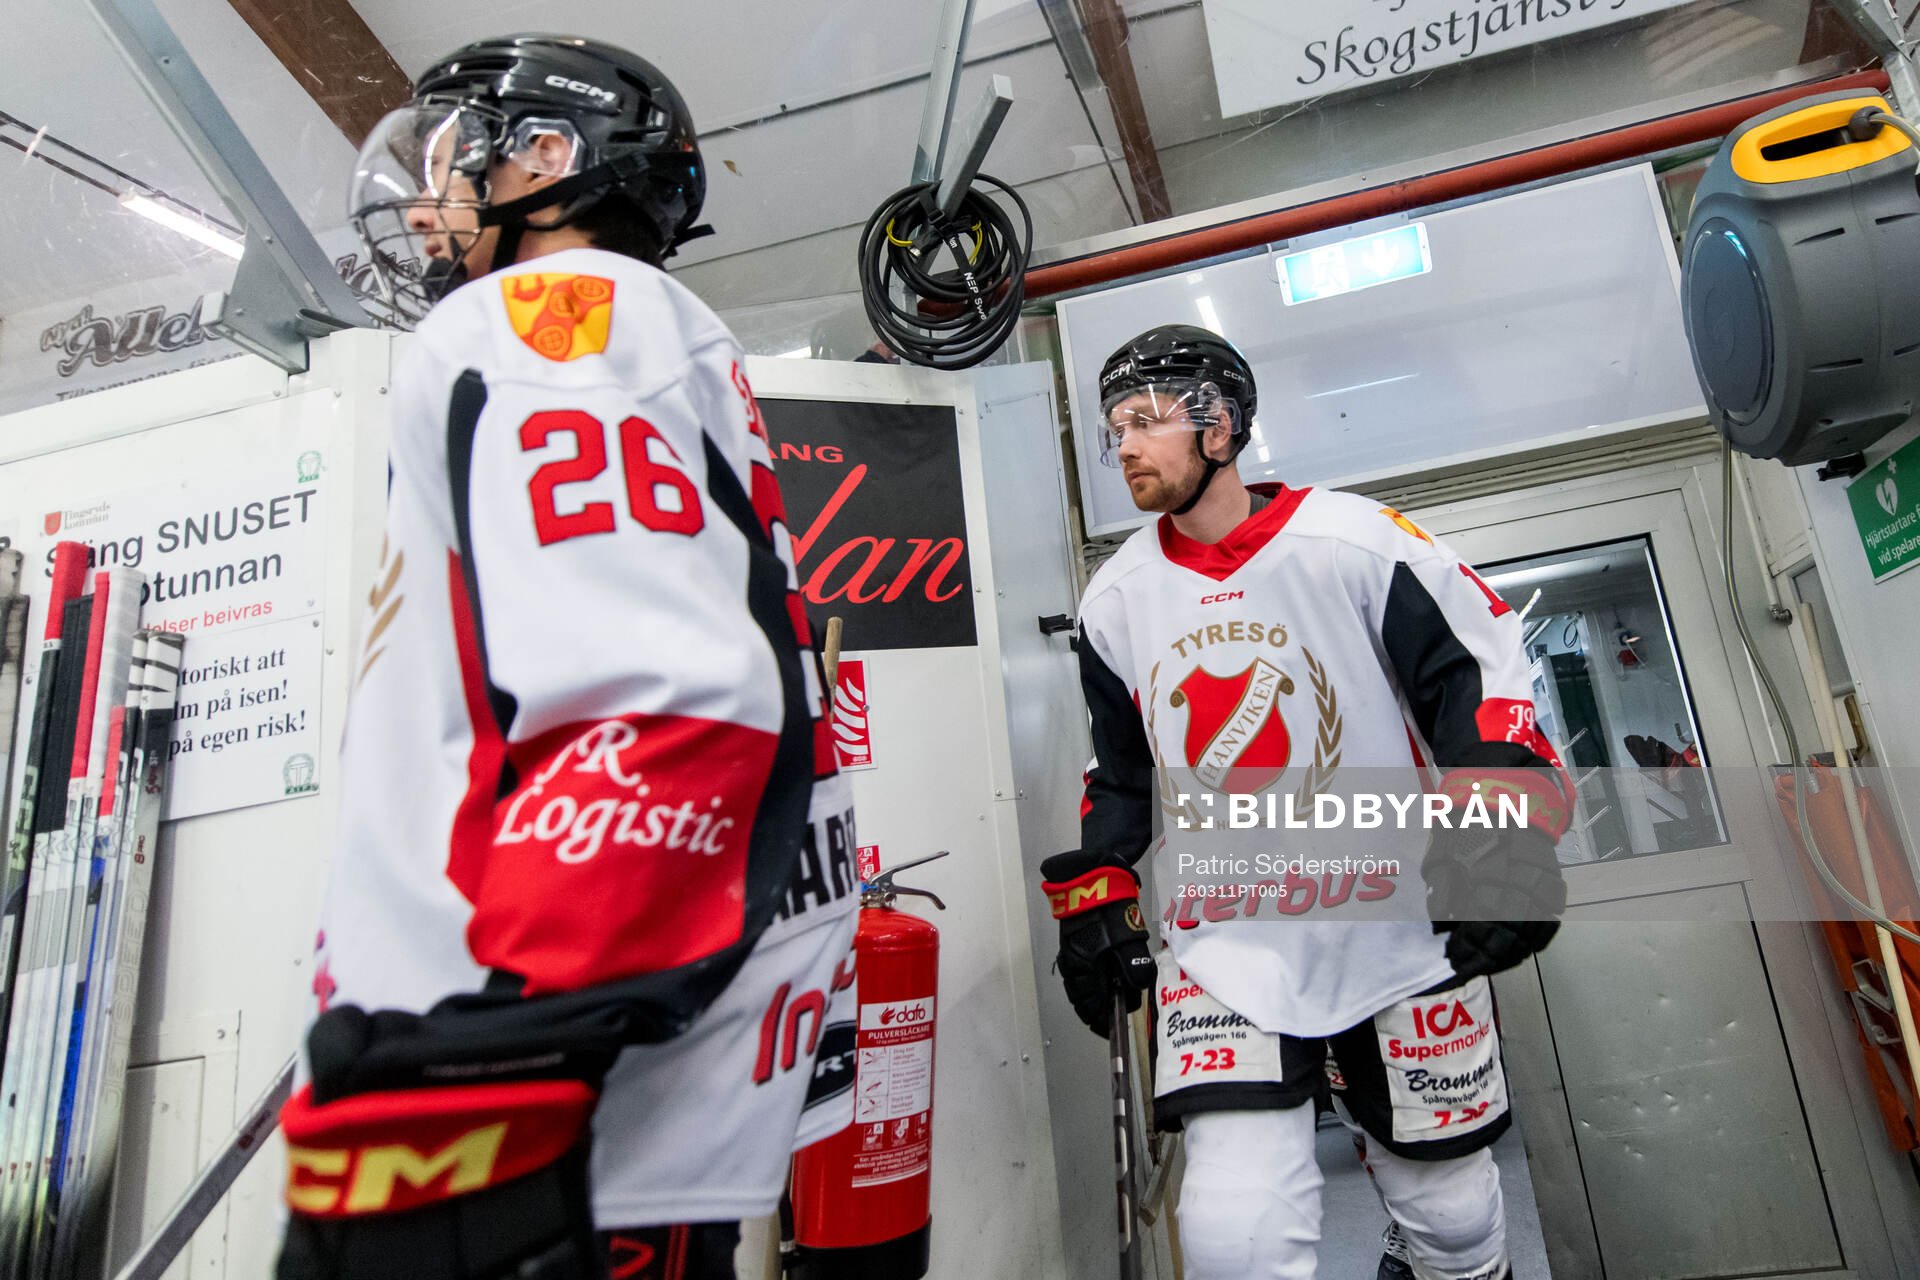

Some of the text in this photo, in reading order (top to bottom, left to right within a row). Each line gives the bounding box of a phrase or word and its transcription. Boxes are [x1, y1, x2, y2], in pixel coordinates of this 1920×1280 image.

[544, 74, 617, 103] CCM
[963, 271, 980, 294] NEP
[1102, 362, 1133, 386] CCM
[1223, 369, 1248, 382] CCM
[518, 408, 705, 547] 26
[157, 488, 317, 554] SNUSET
[1865, 512, 1917, 549] Hjärtstartare
[1878, 547, 1892, 566] vid
[1200, 590, 1245, 605] CCM
[203, 600, 273, 628] beivras
[1170, 620, 1289, 660] TYRESÖ
[177, 648, 286, 687] toriskt att
[206, 689, 232, 720] på
[239, 678, 288, 708] isen!
[169, 709, 306, 761] på egen risk!
[1202, 669, 1276, 782] HANVIKEN
[492, 783, 735, 865] Logistic
[896, 1003, 926, 1023] dafo
[1412, 997, 1474, 1039] ICA
[1172, 1031, 1247, 1049] Spångavägen 166
[1180, 1047, 1236, 1077] 7-23
[1422, 1088, 1480, 1106] Spångavägen
